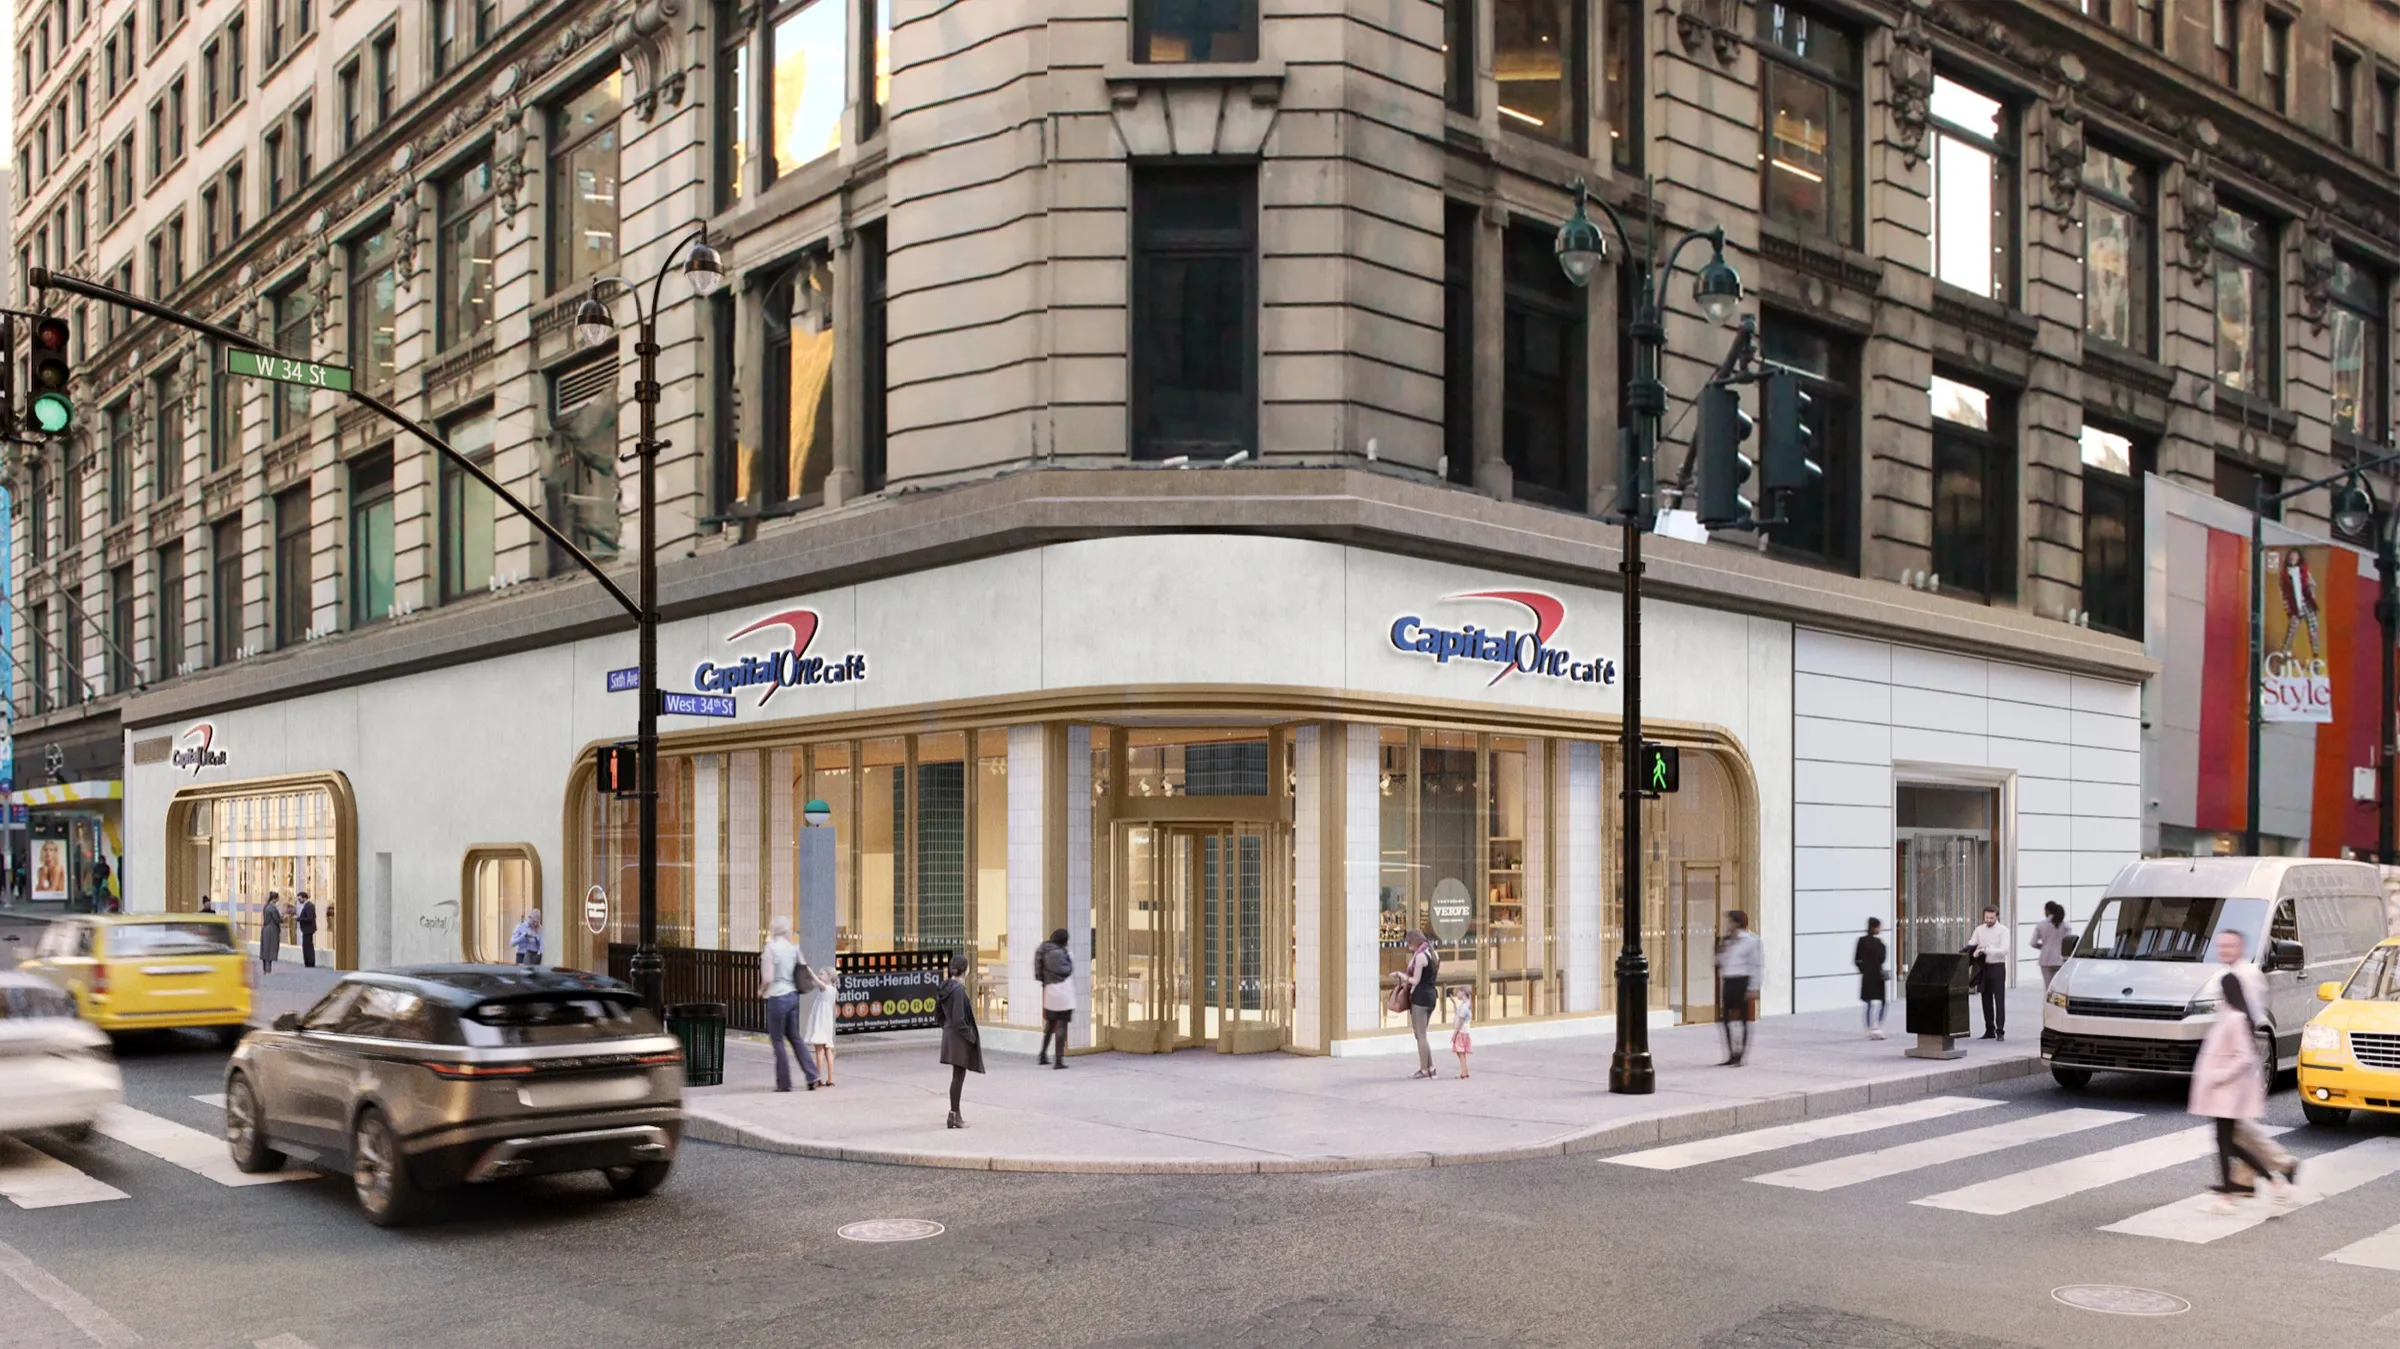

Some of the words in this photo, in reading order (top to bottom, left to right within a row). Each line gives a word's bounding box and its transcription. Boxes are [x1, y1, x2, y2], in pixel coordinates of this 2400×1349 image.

[255, 354, 275, 377] W
[281, 360, 303, 382] 34
[309, 364, 326, 386] St
[823, 654, 865, 684] café
[1570, 657, 1615, 685] café
[2265, 650, 2326, 683] Give
[626, 670, 638, 688] Ave
[666, 694, 696, 713] West
[700, 696, 720, 714] 34th
[721, 698, 733, 715] St
[2260, 678, 2331, 712] Style
[1433, 906, 1470, 917] VERVE
[845, 973, 920, 989] Street-Herald
[924, 972, 939, 987] Sq
[836, 989, 869, 1002] tation
